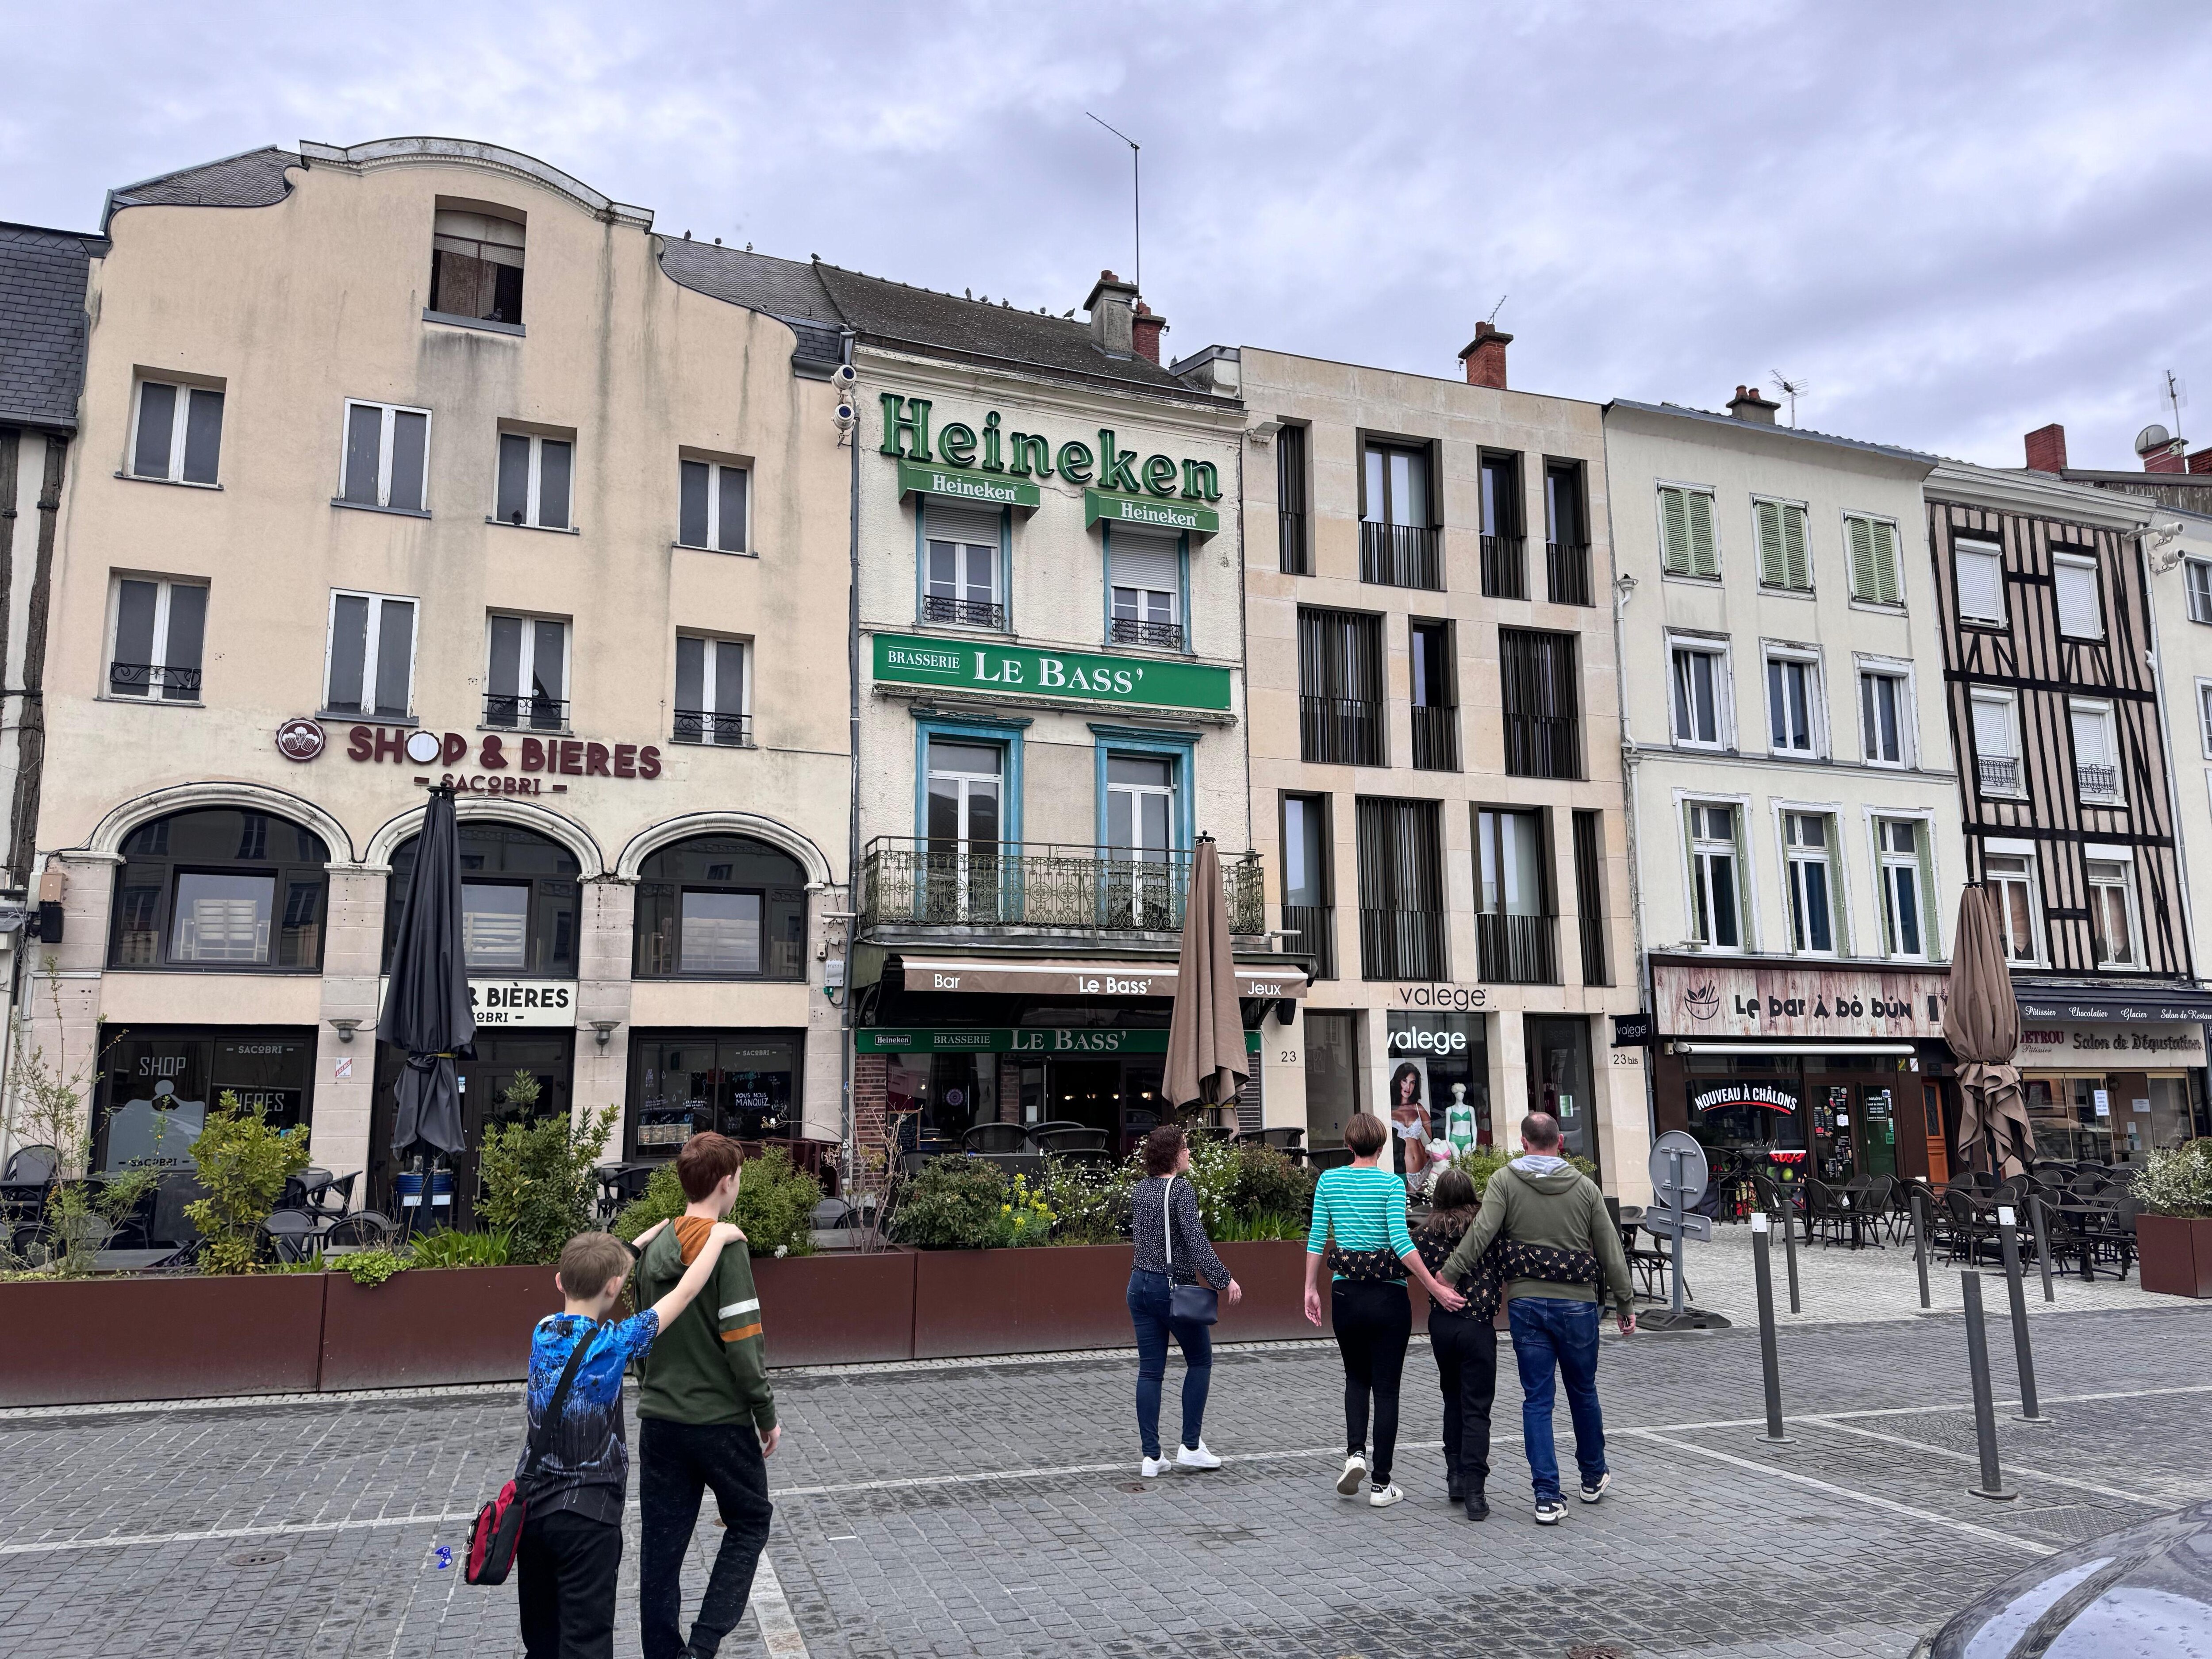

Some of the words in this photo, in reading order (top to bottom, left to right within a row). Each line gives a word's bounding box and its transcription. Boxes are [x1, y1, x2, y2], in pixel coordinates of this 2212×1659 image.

[879, 392, 1223, 502] Heineken
[888, 650, 960, 669] BRASSERIE
[973, 651, 1023, 684] LE
[347, 726, 467, 766] SHOP
[479, 735, 508, 769] &
[521, 737, 662, 779] BIERES
[442, 774, 541, 795] SACOBRI
[487, 982, 569, 1008] BIÈRES
[934, 973, 960, 989] Bar
[1079, 976, 1100, 993] Le
[1106, 976, 1152, 995] Bass'
[1248, 981, 1281, 996] Jeux
[1399, 983, 1486, 1011] valege
[1735, 995, 1761, 1019] Le
[1769, 995, 1805, 1017] bar
[2025, 1006, 2057, 1016] Pâtissier
[2069, 1006, 2108, 1017] Chocolatier
[2121, 1008, 2148, 1021] Glacier
[2161, 1009, 2179, 1019] Salon
[2180, 1010, 2188, 1019] de
[876, 1036, 910, 1044] Heineken
[934, 1035, 990, 1045] BRASSERIE
[1010, 1029, 1044, 1050] LE
[1617, 1024, 1646, 1037] valege
[2073, 1033, 2110, 1050] Salon
[2113, 1033, 2129, 1050] de
[2131, 1033, 2204, 1054] Dégustation
[139, 1057, 186, 1075] SHOP
[1281, 1051, 1296, 1063] 23
[1613, 1054, 1626, 1064] 23
[736, 1097, 770, 1107] MANQUEZ
[1694, 1087, 1740, 1110] NOUVEAU
[1743, 1083, 1751, 1101] À
[1752, 1086, 1797, 1111] CHÂLONS
